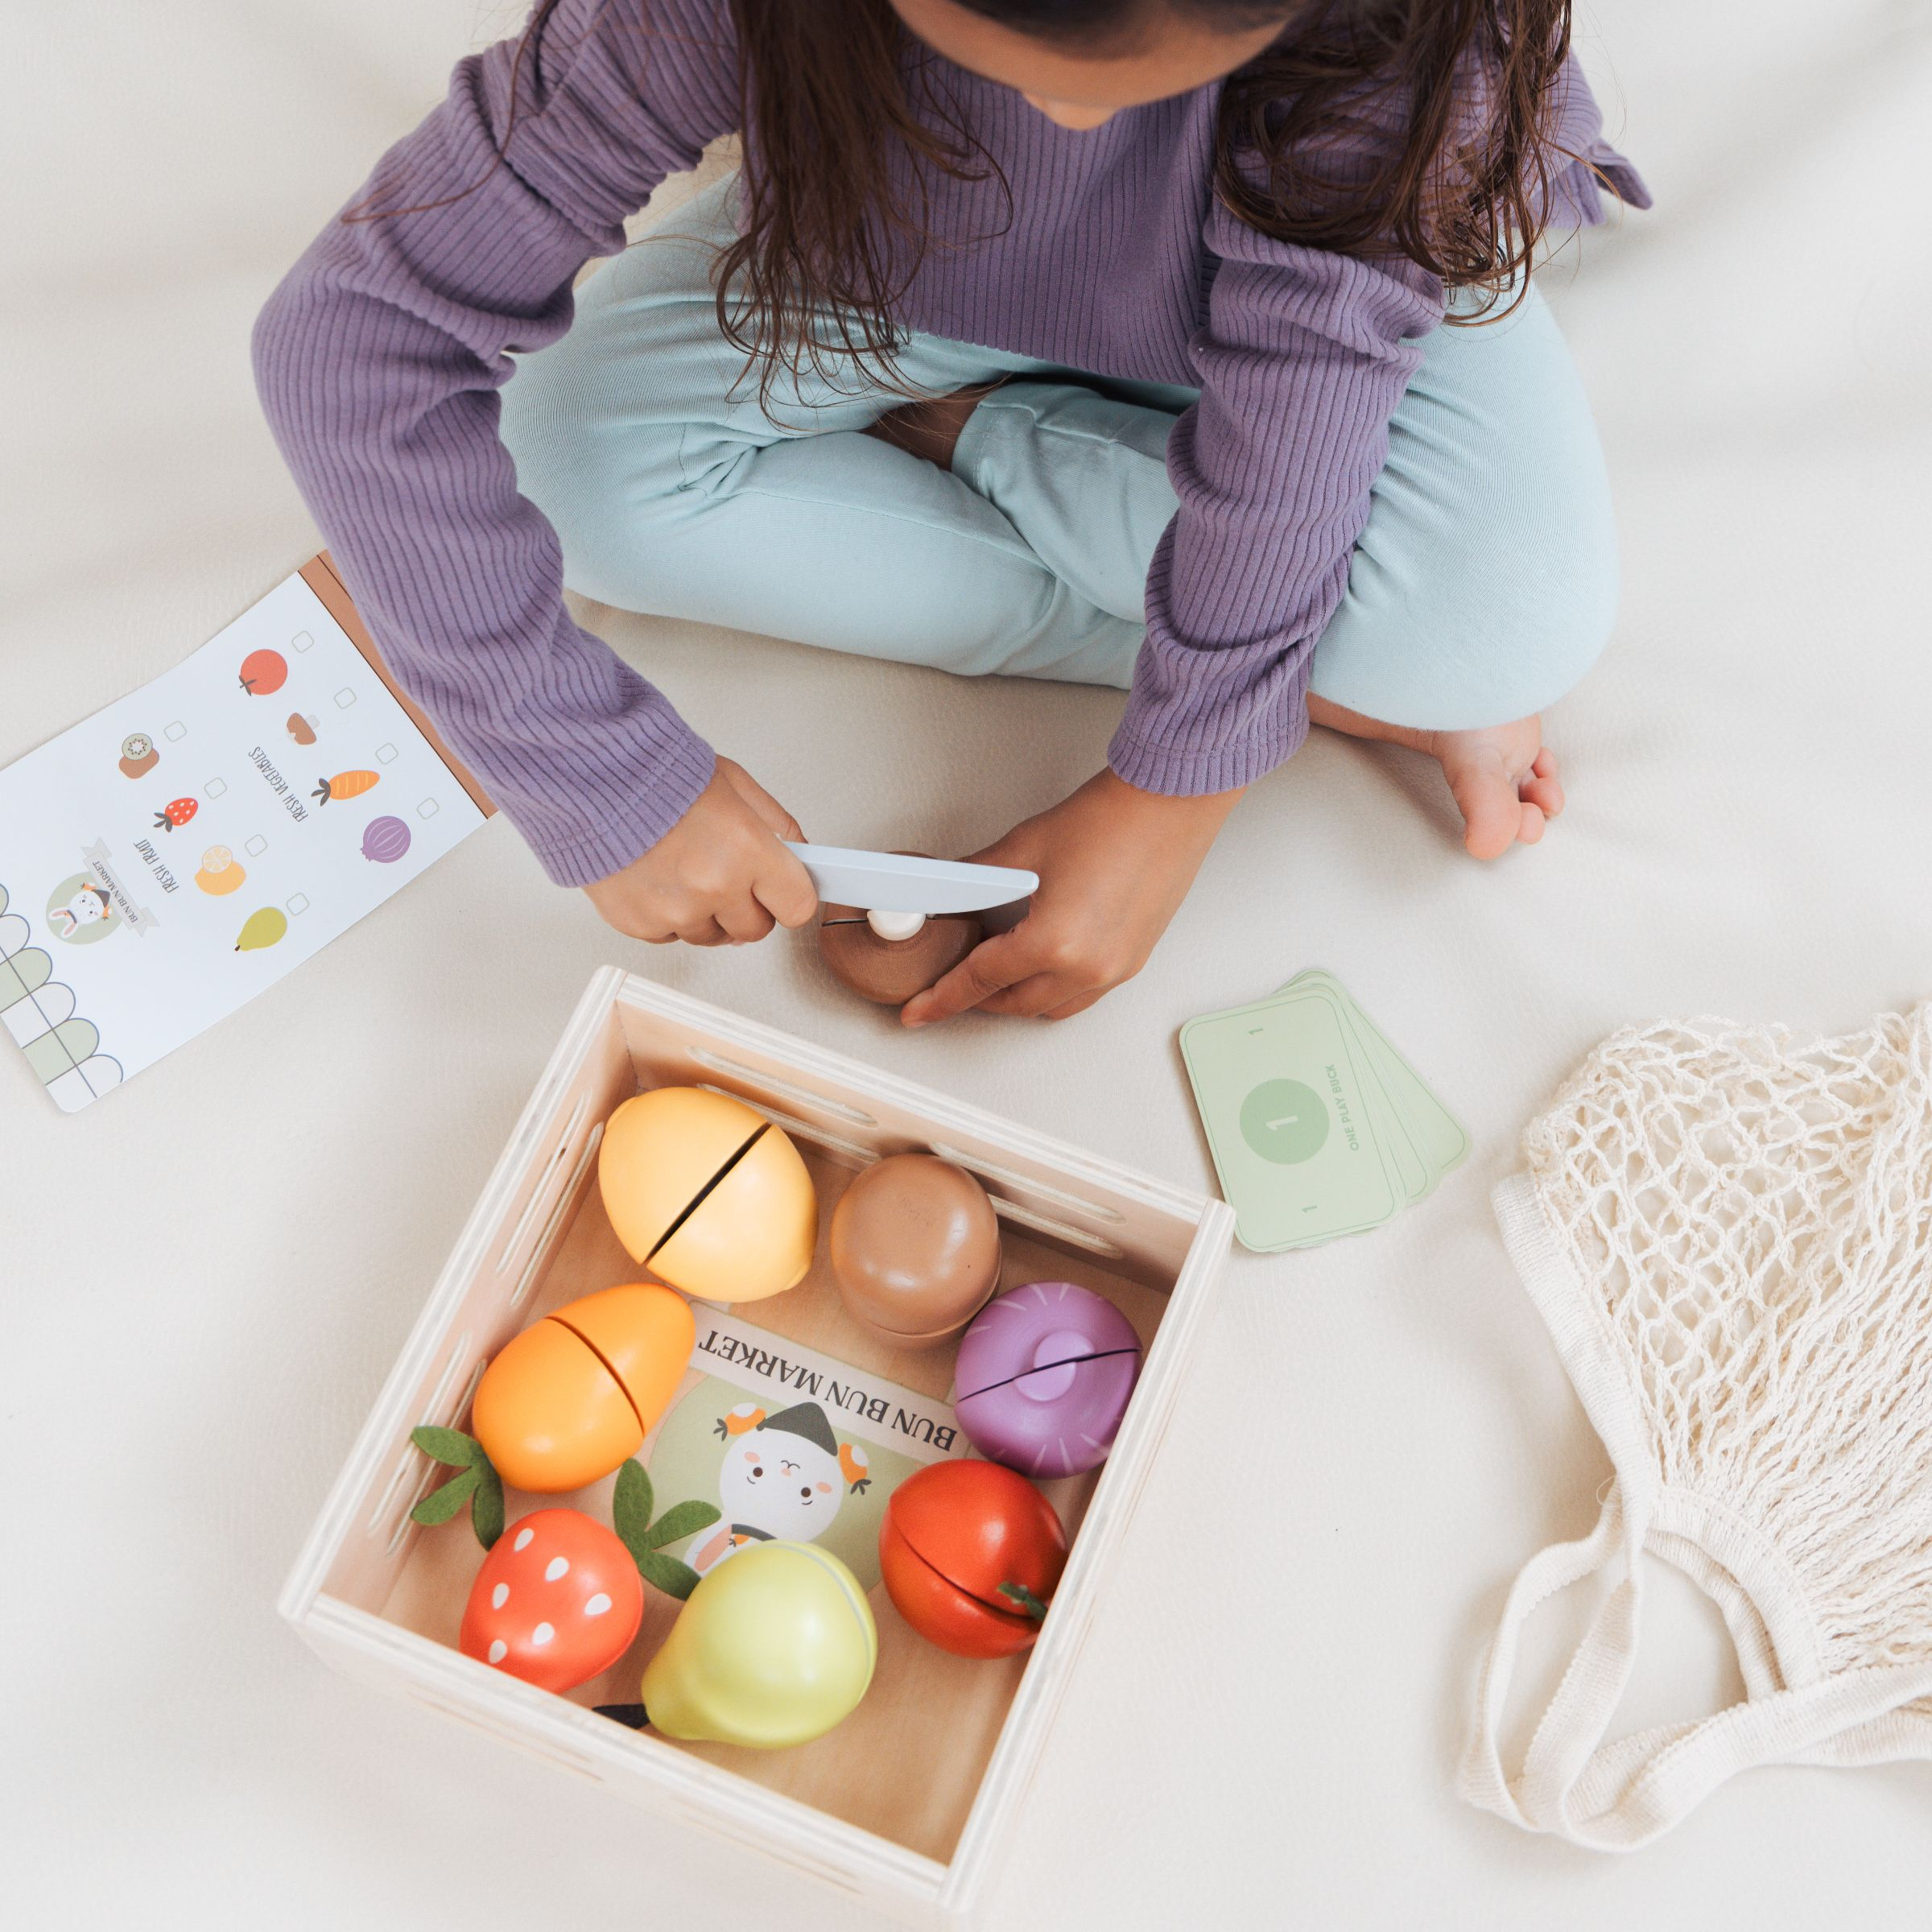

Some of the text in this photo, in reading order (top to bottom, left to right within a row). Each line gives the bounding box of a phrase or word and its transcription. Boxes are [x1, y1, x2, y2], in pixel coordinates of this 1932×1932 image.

[248, 745, 309, 823] FRESH VEGETABLES
[92, 861, 138, 923] BUN BUN MARKET
[133, 838, 180, 894] FRESH FRUIT
[1249, 1027, 1264, 1036] 1
[1265, 1115, 1298, 1131] 1
[1325, 1063, 1360, 1152] ONE PLAY BUCK
[1302, 1204, 1318, 1213] 1
[698, 1330, 957, 1452] BUN BUN MARKET
